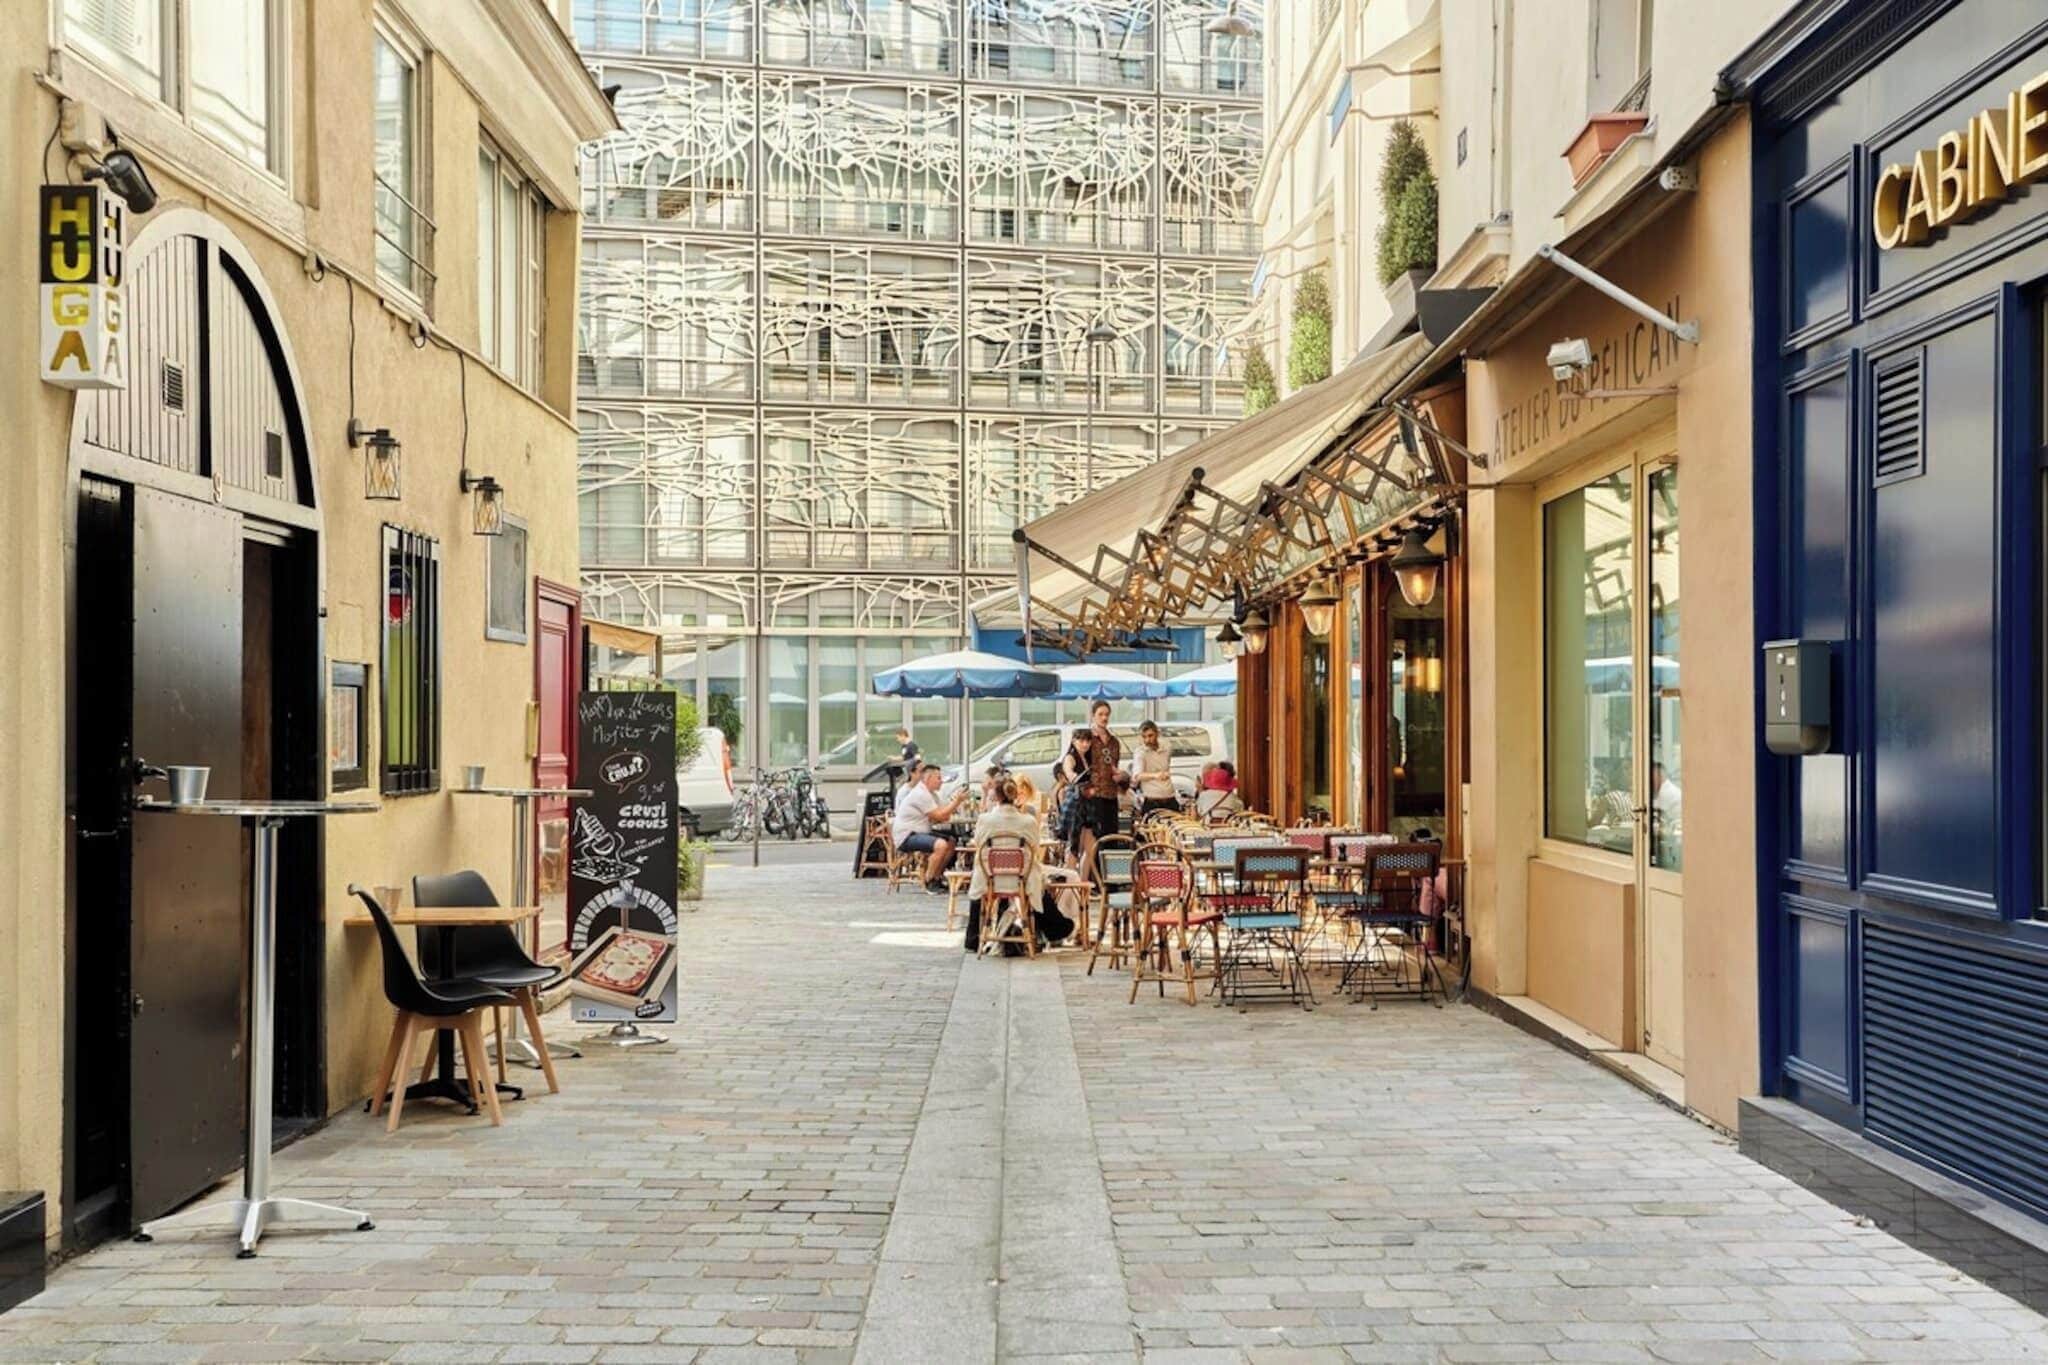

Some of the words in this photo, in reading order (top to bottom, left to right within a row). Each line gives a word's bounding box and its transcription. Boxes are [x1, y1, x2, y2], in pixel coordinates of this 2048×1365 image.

[1873, 71, 2048, 250] CABINE
[49, 195, 92, 372] HUGA
[103, 199, 123, 379] HUGA
[1493, 387, 1551, 467] ATELIER
[212, 471, 223, 504] 9
[592, 722, 645, 747] Mojito
[617, 818, 669, 830] COQUES
